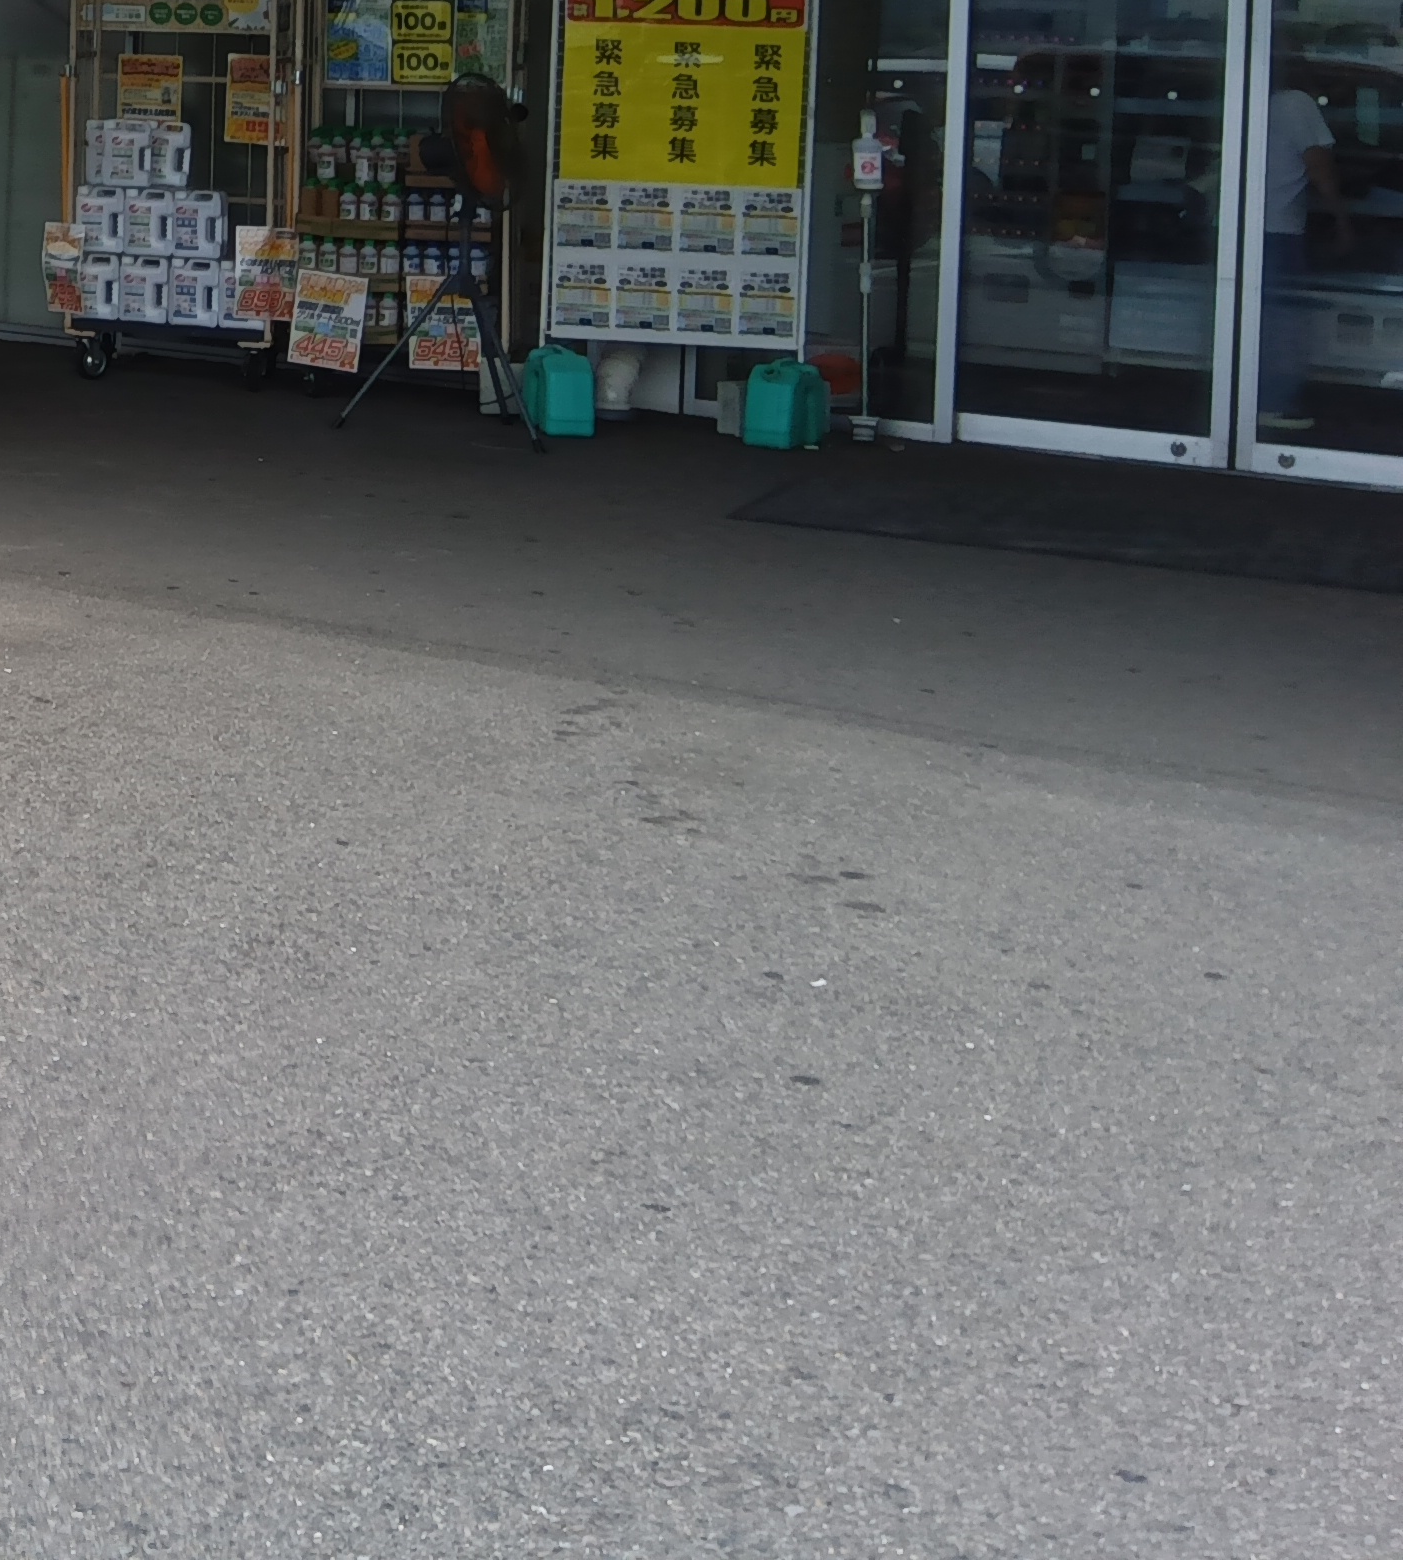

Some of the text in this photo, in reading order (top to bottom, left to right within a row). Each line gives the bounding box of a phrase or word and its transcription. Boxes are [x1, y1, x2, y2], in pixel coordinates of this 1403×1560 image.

[590, 39, 623, 161] 緊急募集
[667, 41, 702, 164] 緊急募集
[748, 44, 782, 167] 緊急募集
